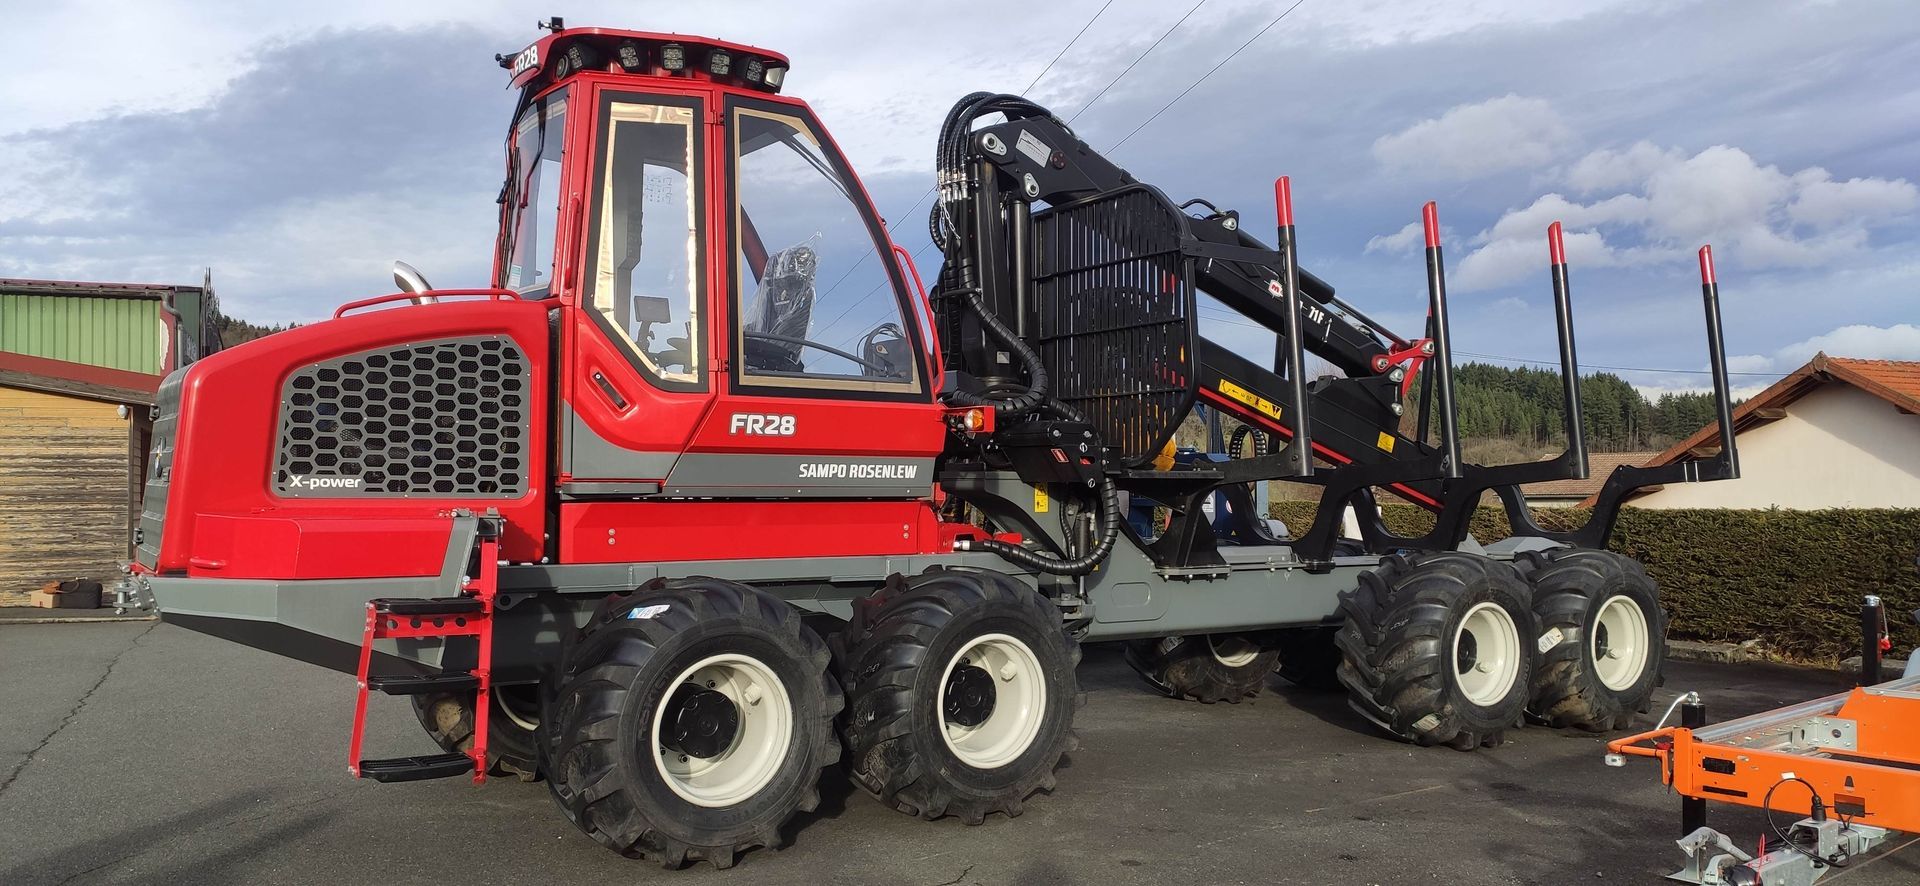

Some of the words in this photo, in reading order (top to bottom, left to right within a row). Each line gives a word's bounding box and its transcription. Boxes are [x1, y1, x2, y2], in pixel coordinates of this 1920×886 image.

[514, 45, 538, 76] FR28
[730, 413, 796, 435] FR28
[799, 463, 846, 478] SAMPO
[849, 464, 917, 479] ROSENLEW
[289, 475, 361, 490] X-power
